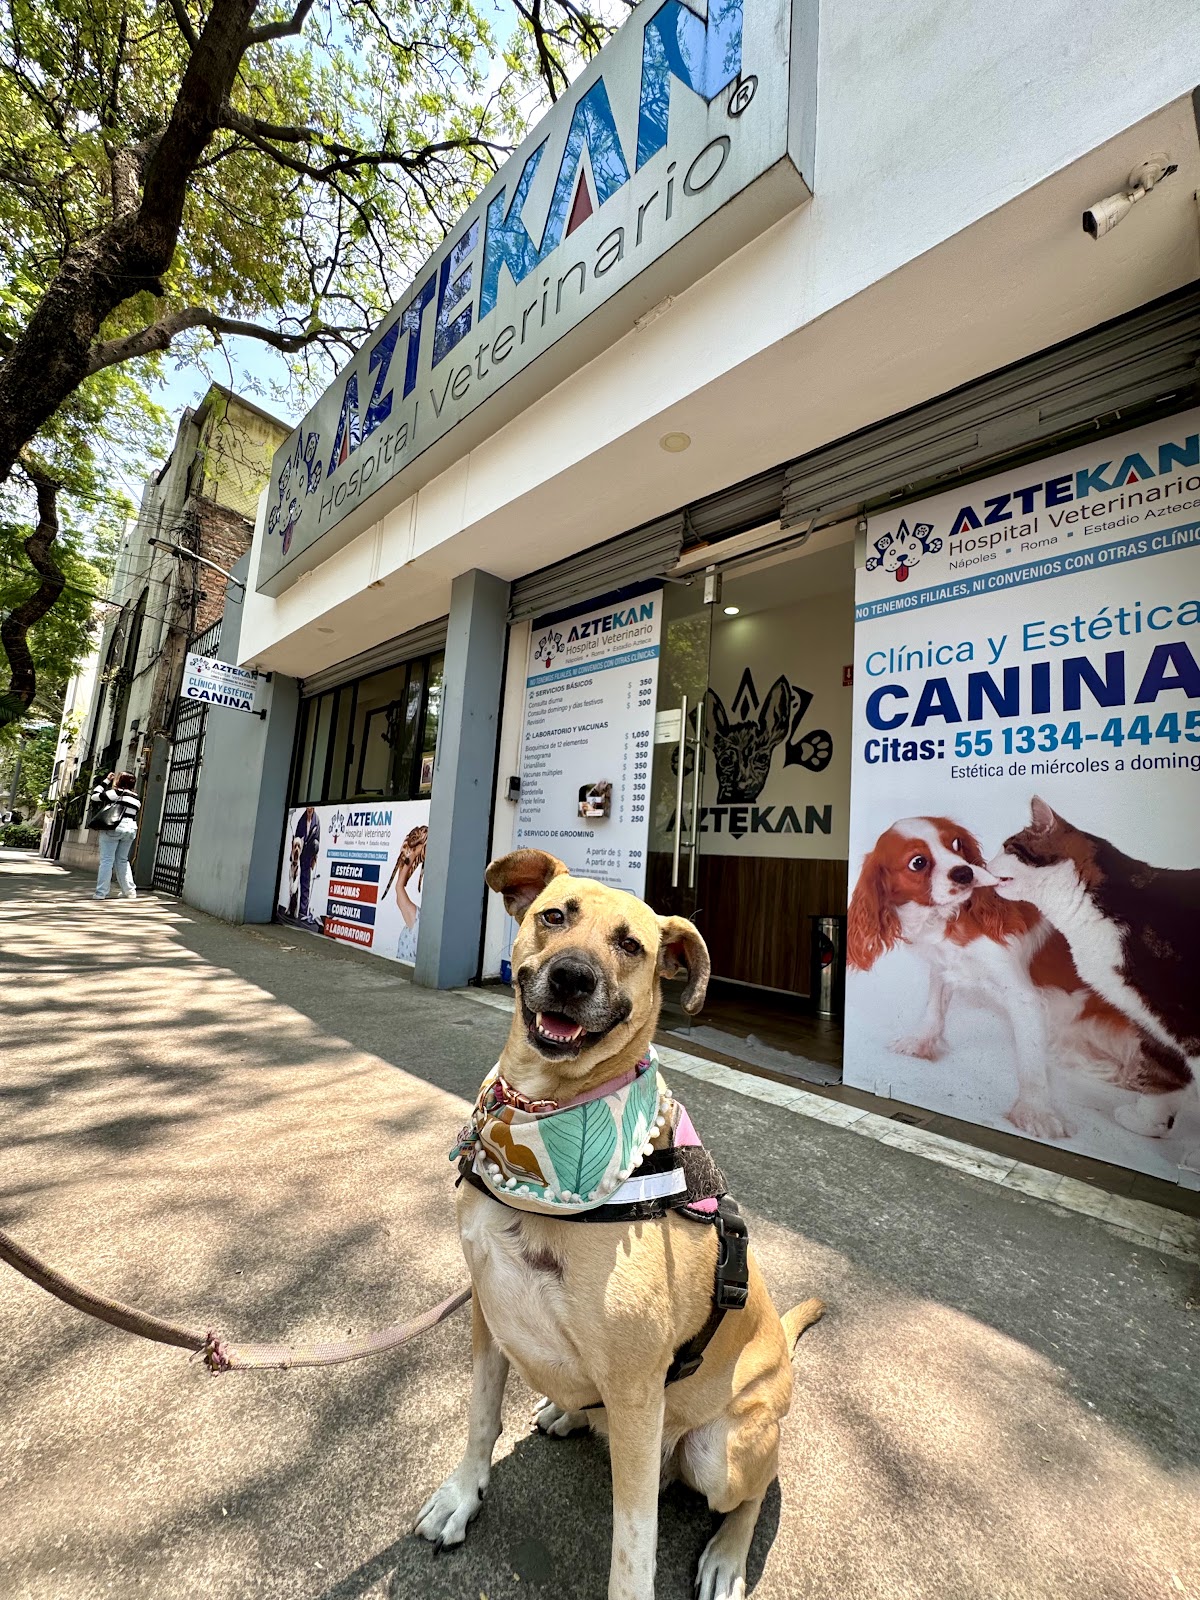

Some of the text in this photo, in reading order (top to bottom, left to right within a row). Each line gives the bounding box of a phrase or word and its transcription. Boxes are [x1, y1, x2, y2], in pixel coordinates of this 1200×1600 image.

[327, 0, 743, 479] AZTEKAN
[318, 135, 731, 524] Hospital Veterinario
[948, 433, 1200, 536] AZTEKAN
[949, 476, 1200, 556] Hospital Veterinario
[949, 499, 1200, 571] Nápoles Roma Estadio Azteca
[855, 607, 869, 619] NO
[871, 595, 918, 614] TENEMOS
[920, 583, 970, 603] FILIALES,
[973, 579, 985, 591] NI
[988, 561, 1062, 588] CONVENIOS
[1065, 553, 1095, 570] CON
[1098, 541, 1148, 560] OTRAS
[567, 602, 654, 643] AZTEKAN
[566, 624, 653, 655] Hospital Veterinario
[865, 600, 1200, 677] Clínica y Estética
[603, 661, 614, 669] CON
[614, 656, 631, 666] OTRAS
[188, 678, 217, 691] CLÍNICA
[218, 684, 223, 692] Y
[223, 686, 253, 701] ESTÉTICA
[535, 679, 593, 697] SERVICIOS BÁSICOS
[639, 678, 652, 686] 350
[865, 641, 1200, 731] CANINA
[187, 687, 251, 710] CANINA
[638, 689, 652, 697] 500
[527, 708, 547, 717] Consulta
[547, 705, 568, 714] domingo
[583, 698, 604, 707] festivos
[528, 700, 547, 708] Consulta
[638, 699, 651, 707] 300
[532, 728, 572, 739] LABORATORIO
[578, 722, 609, 731] VACUNAS
[632, 730, 650, 739] 1,050
[864, 710, 1200, 764] Citas: 55 1334-4445
[562, 738, 589, 747] elementos
[635, 741, 648, 749] 450
[524, 752, 551, 760] Hemograma
[951, 763, 1003, 779] Estética
[1008, 762, 1027, 776] de
[1031, 757, 1109, 775] miércoles
[1115, 759, 1124, 771] a
[346, 811, 392, 826] AZTEKAN
[364, 829, 391, 838] Veterinario
[592, 848, 607, 856] partir
[608, 848, 615, 856] de
[629, 850, 642, 858] 200
[335, 864, 363, 878] ESTÉTICA
[591, 858, 606, 866] partir
[628, 861, 642, 869] 250
[333, 885, 361, 898] VACUNAS
[331, 904, 361, 919] CONSULTA
[329, 923, 371, 943] LABORATORIO
